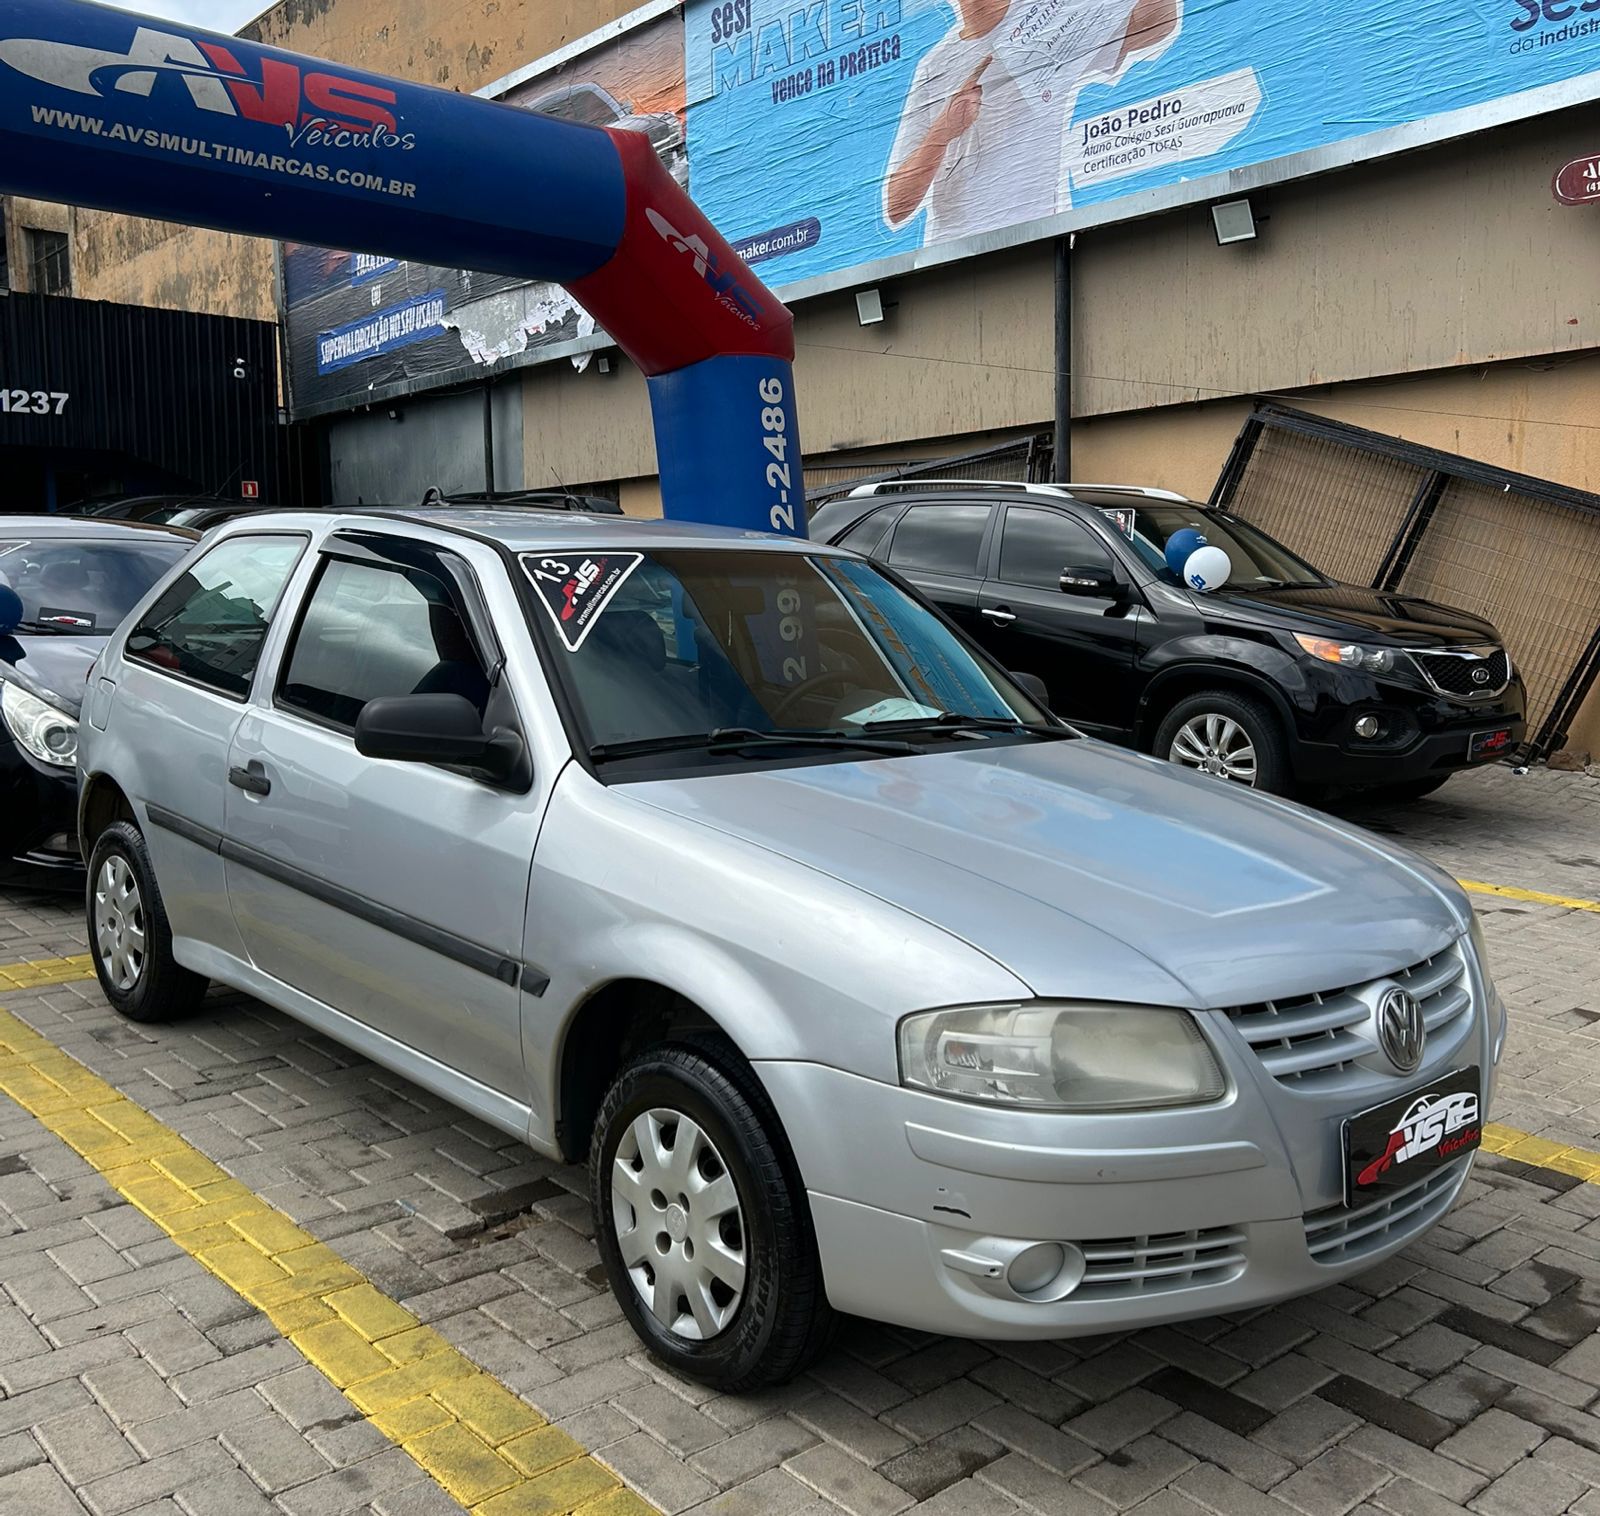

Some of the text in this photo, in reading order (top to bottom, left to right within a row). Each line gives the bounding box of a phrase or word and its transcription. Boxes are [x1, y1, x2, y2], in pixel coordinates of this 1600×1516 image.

[711, 0, 902, 97] MAKER
[1509, 38, 1534, 54] da
[88, 27, 398, 133] AVS
[772, 67, 813, 105] vence
[817, 59, 836, 89] na
[284, 118, 417, 151] Veículos
[1082, 99, 1182, 146] João Pedro
[1083, 101, 1246, 158] Aluno Colégio Sesi Guarapuava
[31, 104, 417, 198] WWW.AVSMULTIMARCAS.COM.BR
[1084, 135, 1183, 174] Certificação TOFAS
[714, 291, 761, 331] Veículos
[759, 377, 795, 531] 2-2486
[533, 559, 571, 583] 13
